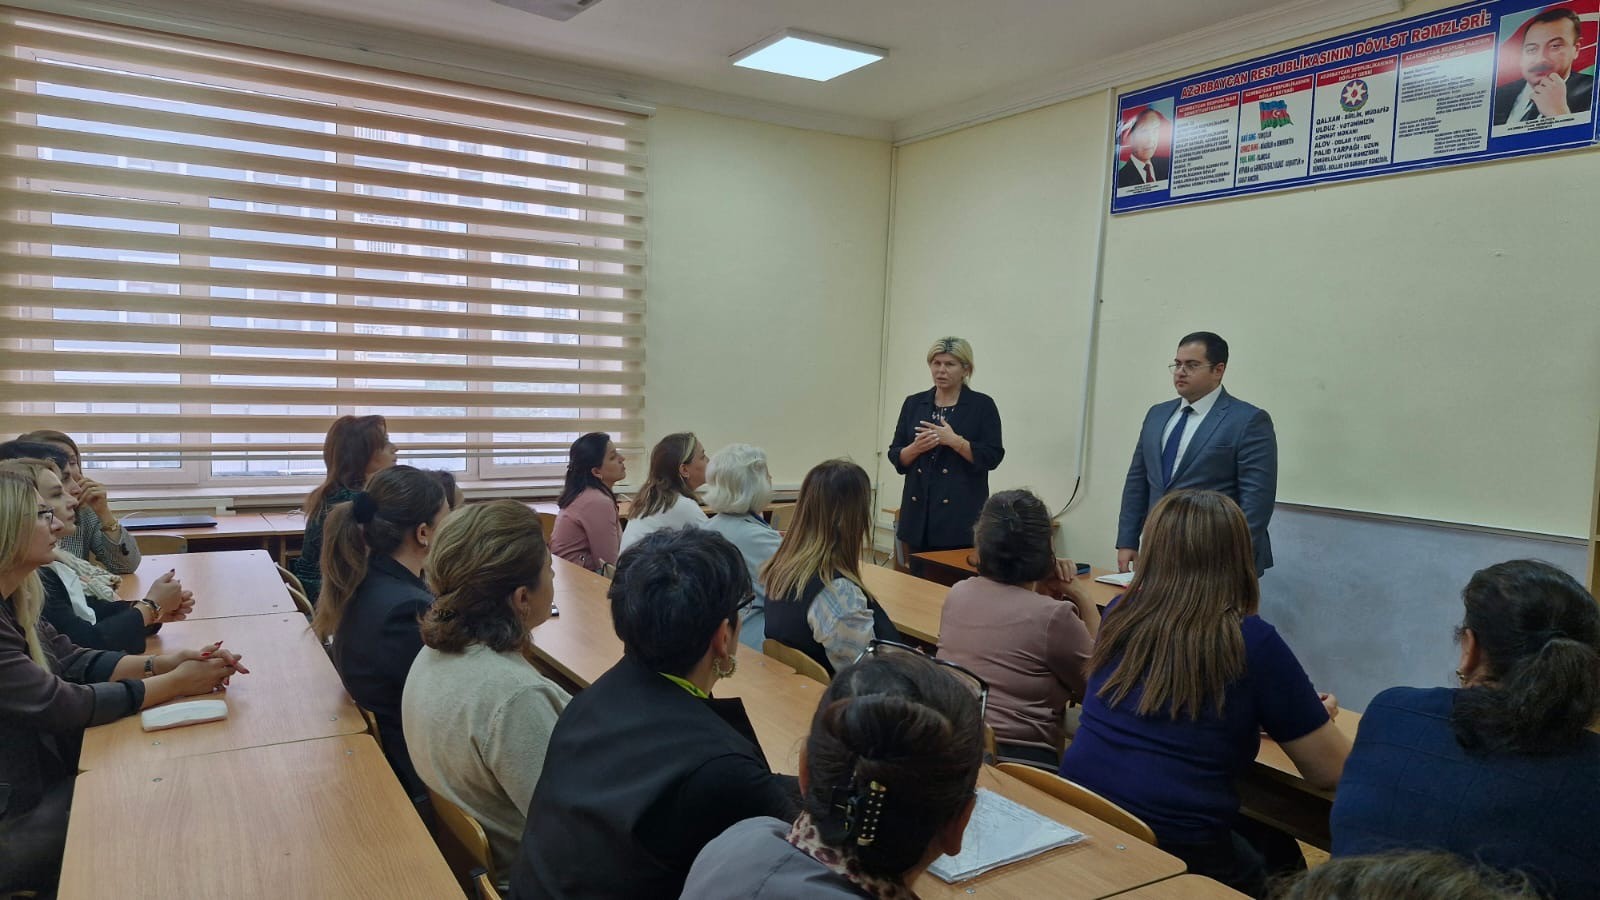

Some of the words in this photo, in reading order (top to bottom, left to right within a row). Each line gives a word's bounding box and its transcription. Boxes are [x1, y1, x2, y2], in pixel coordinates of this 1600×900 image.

[1182, 72, 1248, 99] AZƏRBAYCAN
[1251, 47, 1354, 81] RESPUBLİKASININ
[1356, 32, 1409, 57] DÖVLƏT
[1411, 9, 1491, 43] RƏMZLƏRİ:
[1315, 140, 1330, 149] ALOV
